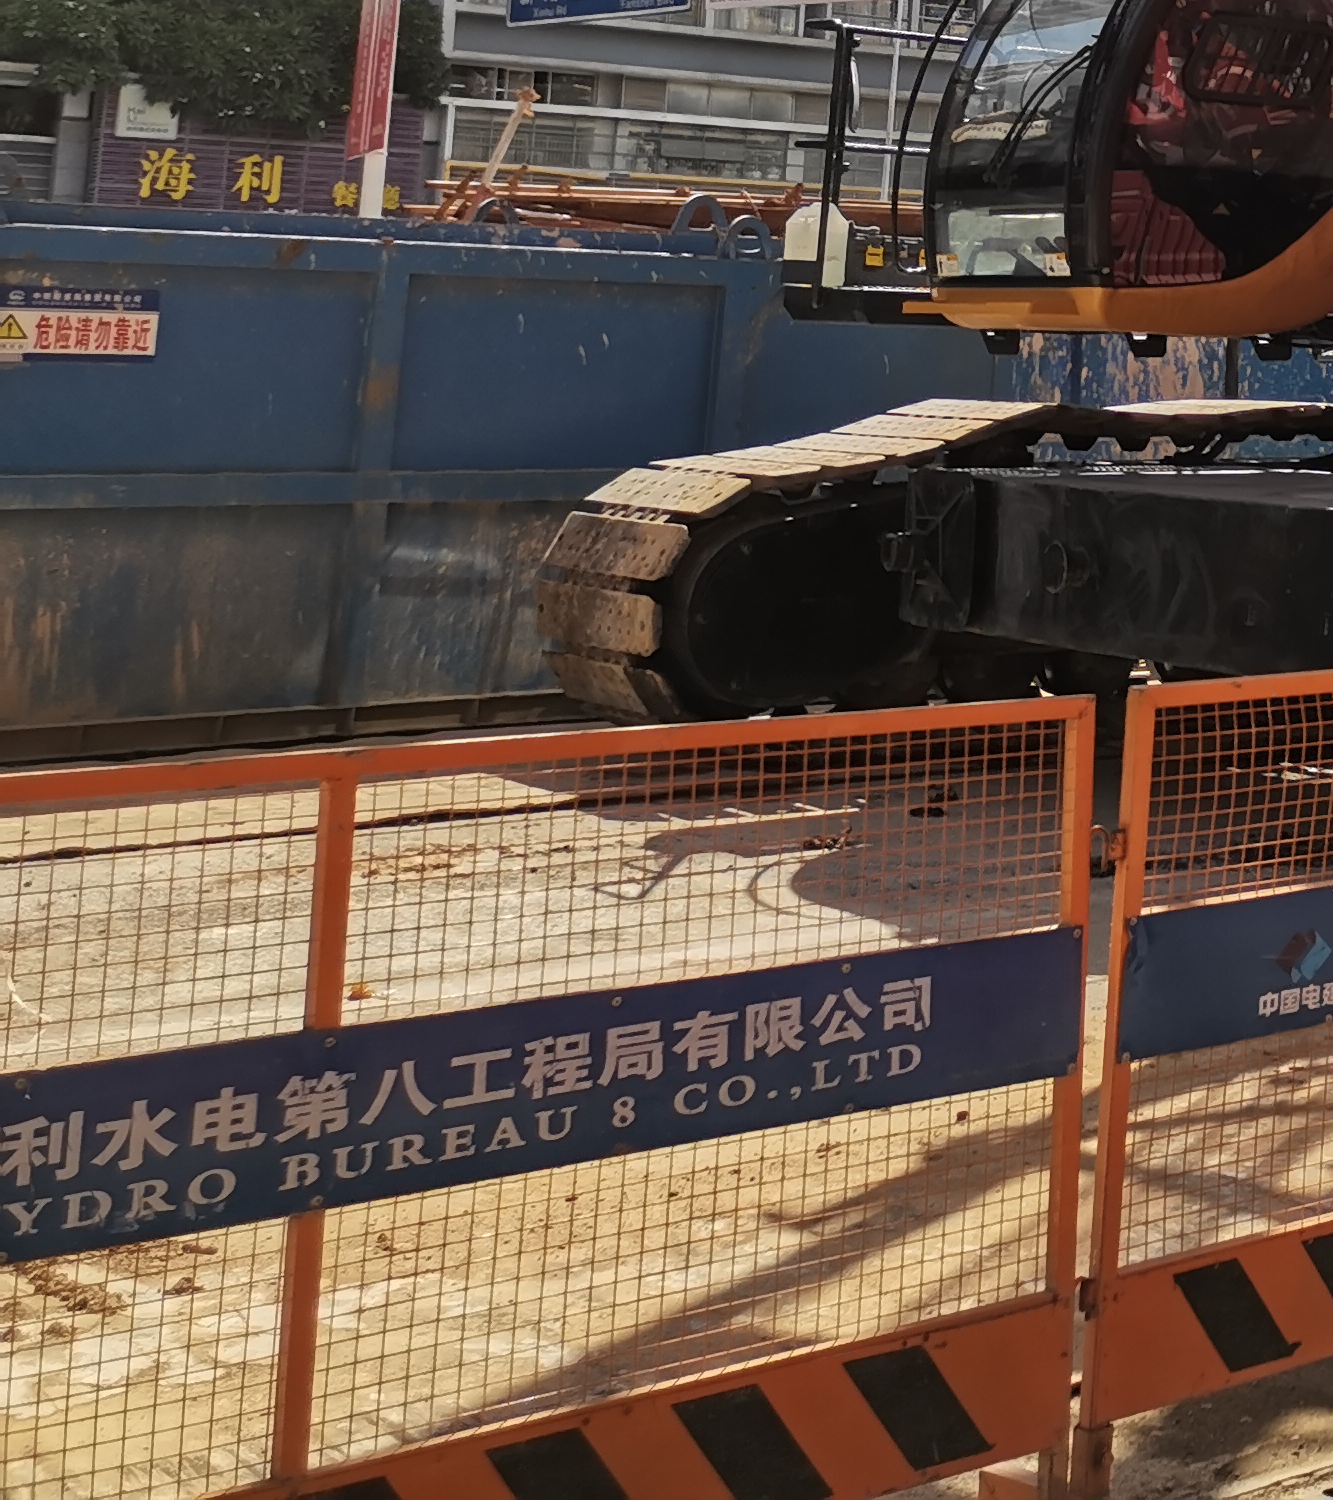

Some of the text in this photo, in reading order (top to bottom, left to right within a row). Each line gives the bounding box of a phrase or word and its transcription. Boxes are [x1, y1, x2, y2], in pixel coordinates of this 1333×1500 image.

[138, 147, 285, 204] 海利
[33, 314, 152, 352] 危险请勿靠近
[0, 976, 932, 1188] 利水电第八工程局有限公司
[3, 1043, 923, 1237] YDRO BUREAU 8 CO.,LTD
